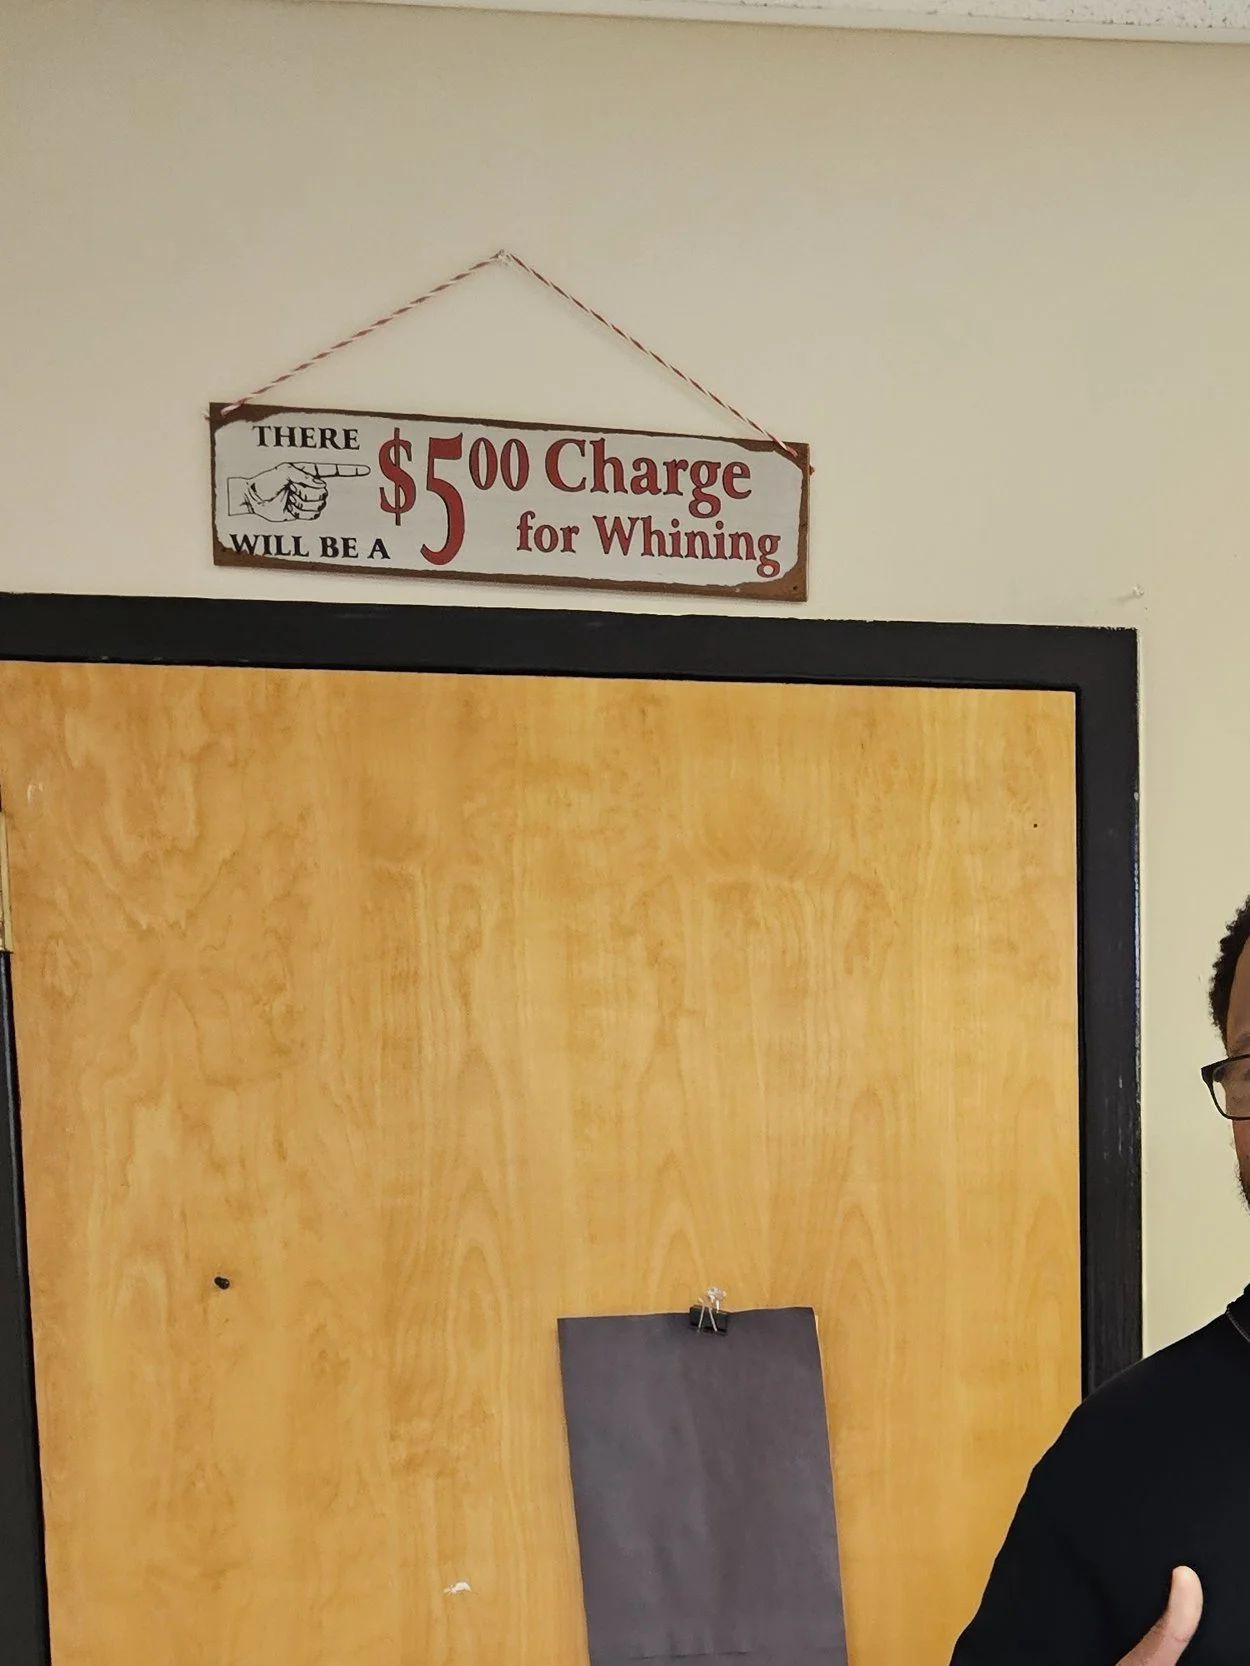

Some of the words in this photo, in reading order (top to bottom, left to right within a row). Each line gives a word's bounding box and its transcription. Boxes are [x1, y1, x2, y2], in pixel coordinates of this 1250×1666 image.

[252, 425, 361, 450] THERE
[545, 437, 752, 519] Charge
[229, 533, 310, 558] WILL
[319, 536, 360, 559] BE
[366, 538, 391, 560] A
[516, 510, 580, 554] for
[592, 515, 781, 579] Whining
